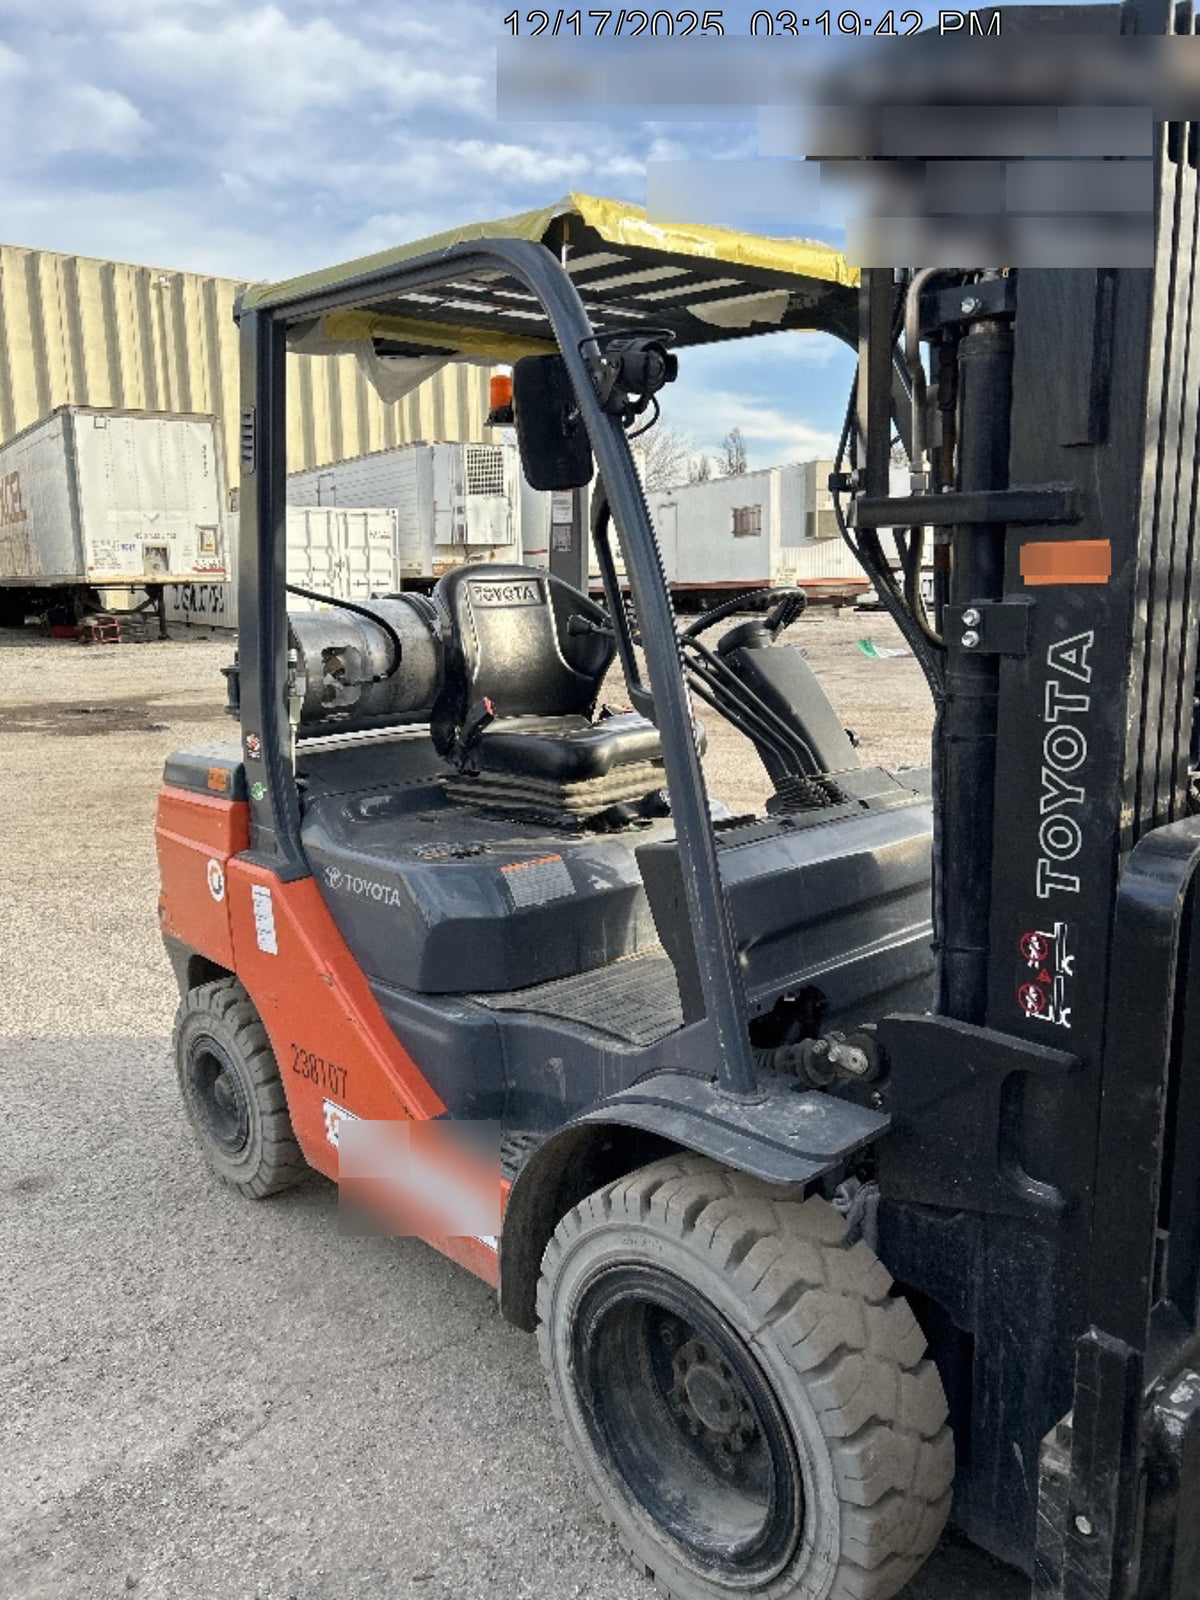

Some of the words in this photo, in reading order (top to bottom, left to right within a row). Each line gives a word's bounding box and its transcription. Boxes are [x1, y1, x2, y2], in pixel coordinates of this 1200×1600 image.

[473, 586, 537, 602] TOYOTA
[1036, 630, 1095, 899] TOYOTA
[343, 873, 401, 908] TOYOTA
[290, 1042, 348, 1099] 238107
